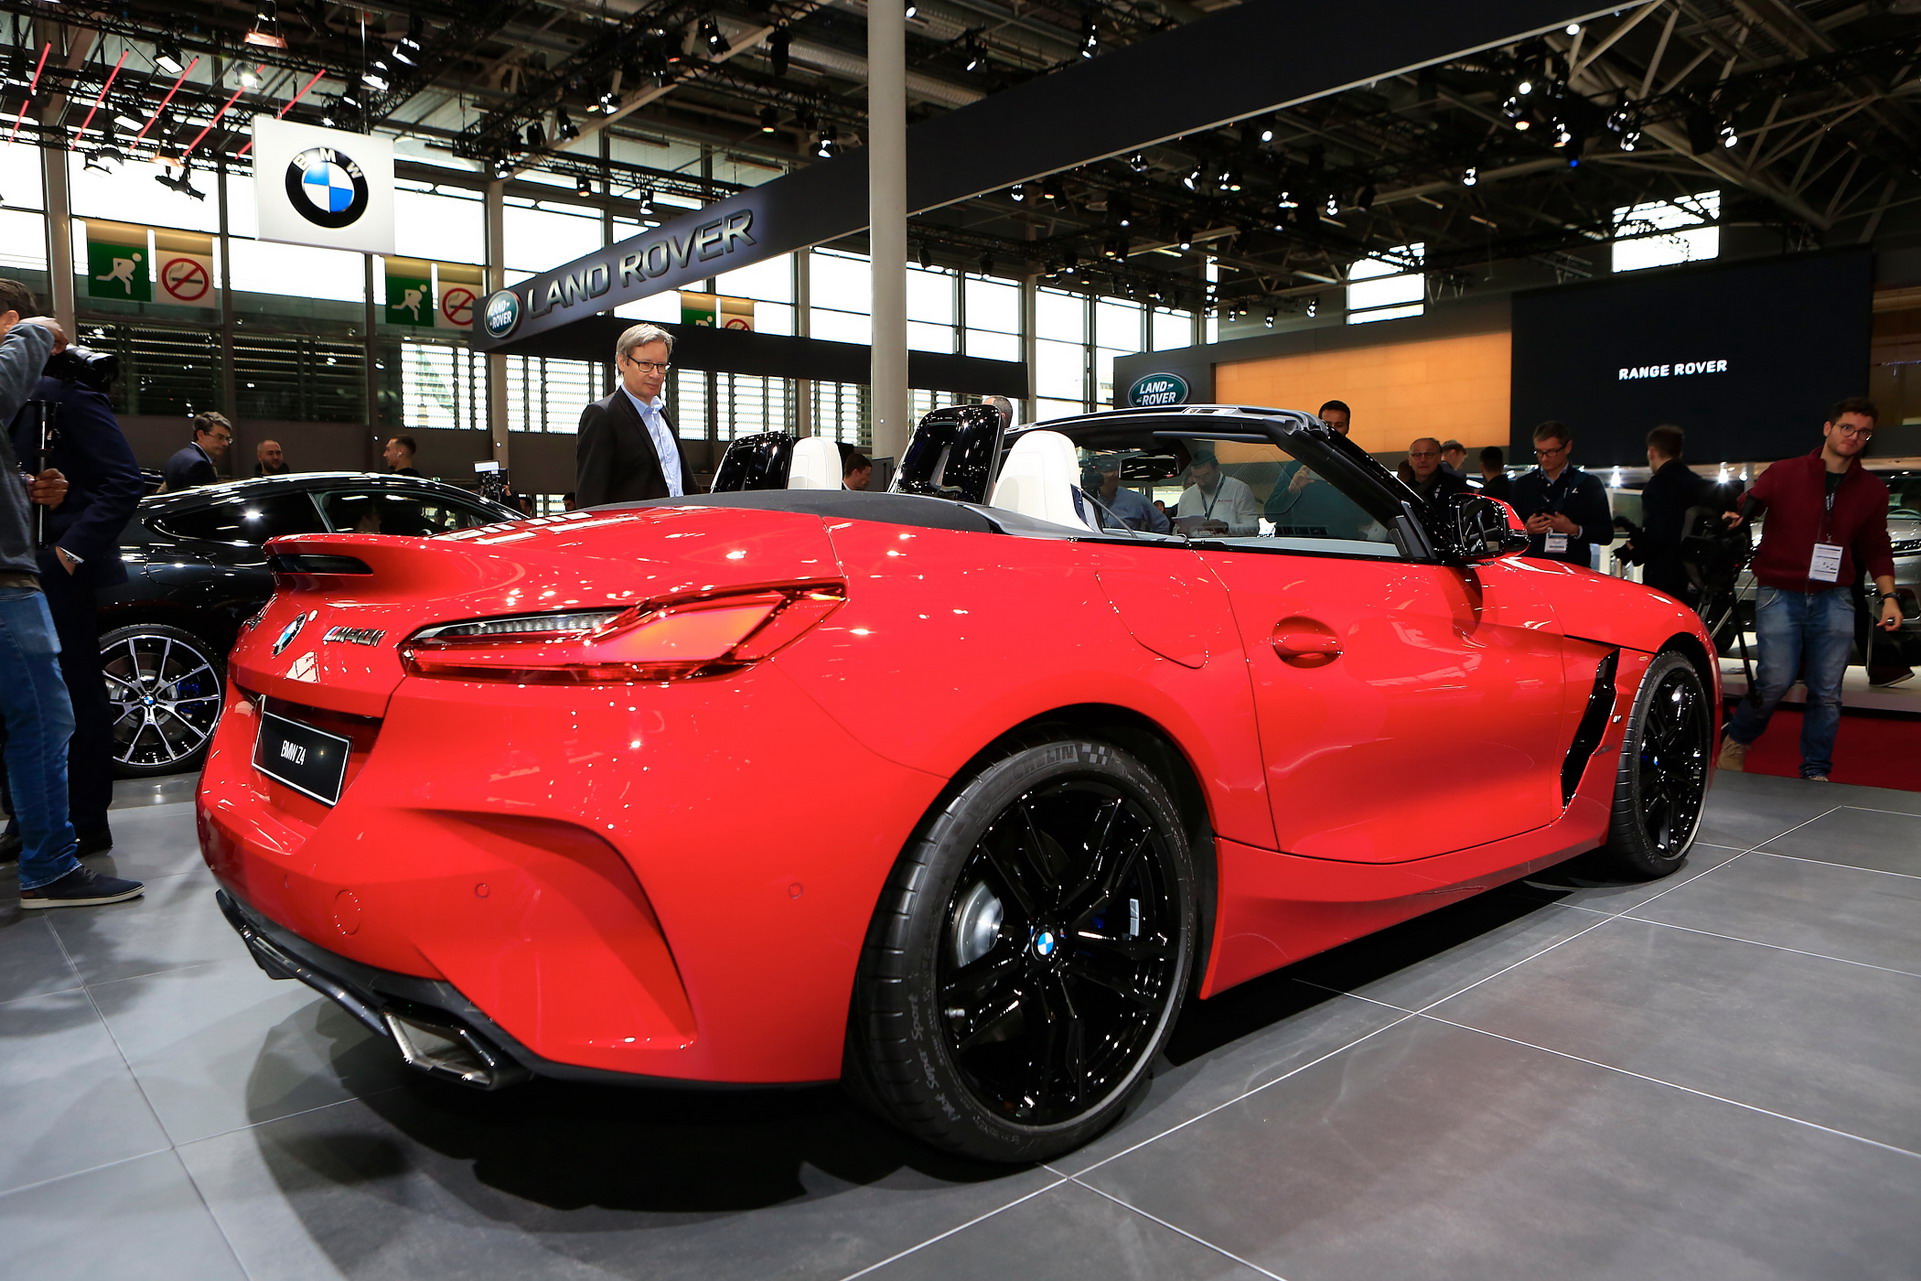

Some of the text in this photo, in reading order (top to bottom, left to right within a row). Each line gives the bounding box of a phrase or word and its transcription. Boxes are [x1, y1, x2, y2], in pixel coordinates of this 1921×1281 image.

[292, 147, 363, 179] BMW
[528, 208, 756, 319] LAND ROVER
[492, 310, 512, 329] ROVER
[1618, 359, 1728, 380] RANGE ROVER
[1139, 380, 1168, 395] LAND
[1141, 391, 1176, 406] ROVER
[281, 739, 307, 766] BMW Z4
